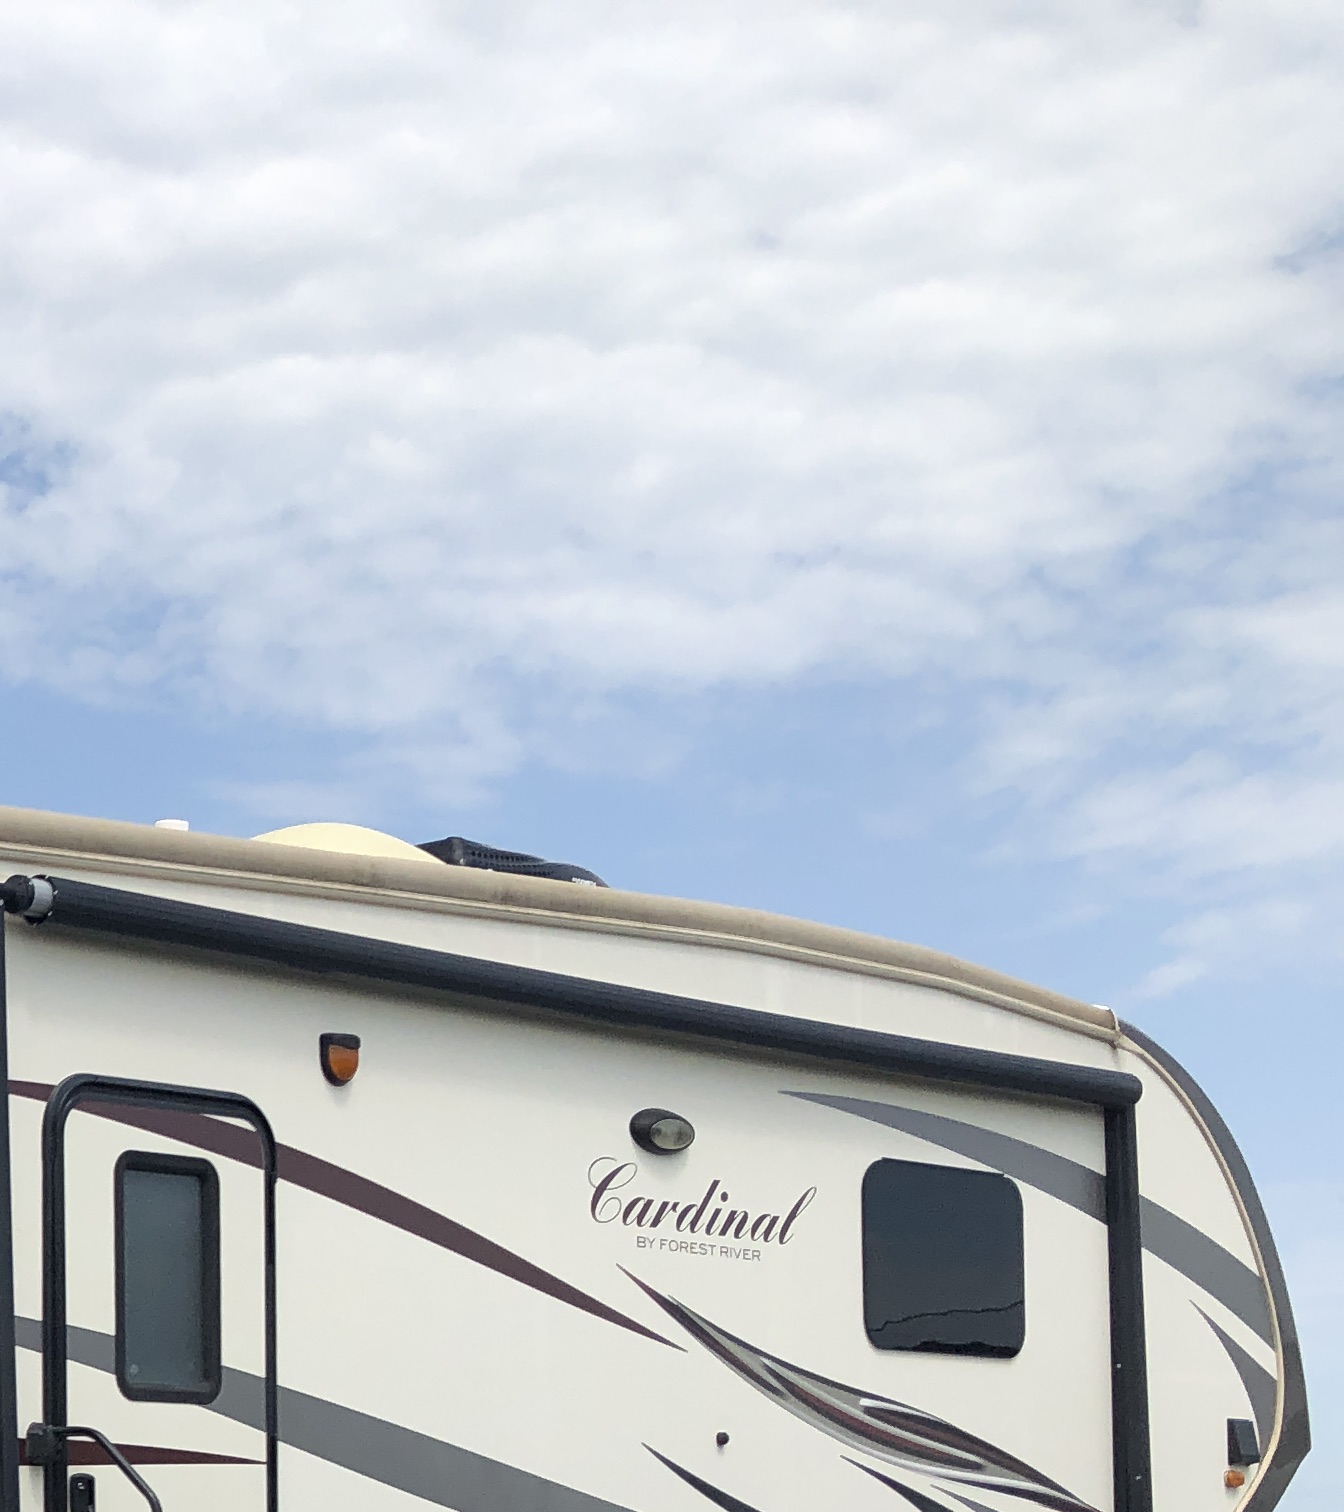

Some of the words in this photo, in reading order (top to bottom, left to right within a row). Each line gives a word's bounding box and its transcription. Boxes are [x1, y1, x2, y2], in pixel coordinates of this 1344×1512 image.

[587, 1155, 817, 1245] Cardinal
[636, 1235, 656, 1249] BY
[659, 1238, 716, 1256] FOREST
[719, 1245, 761, 1262] RIVER
